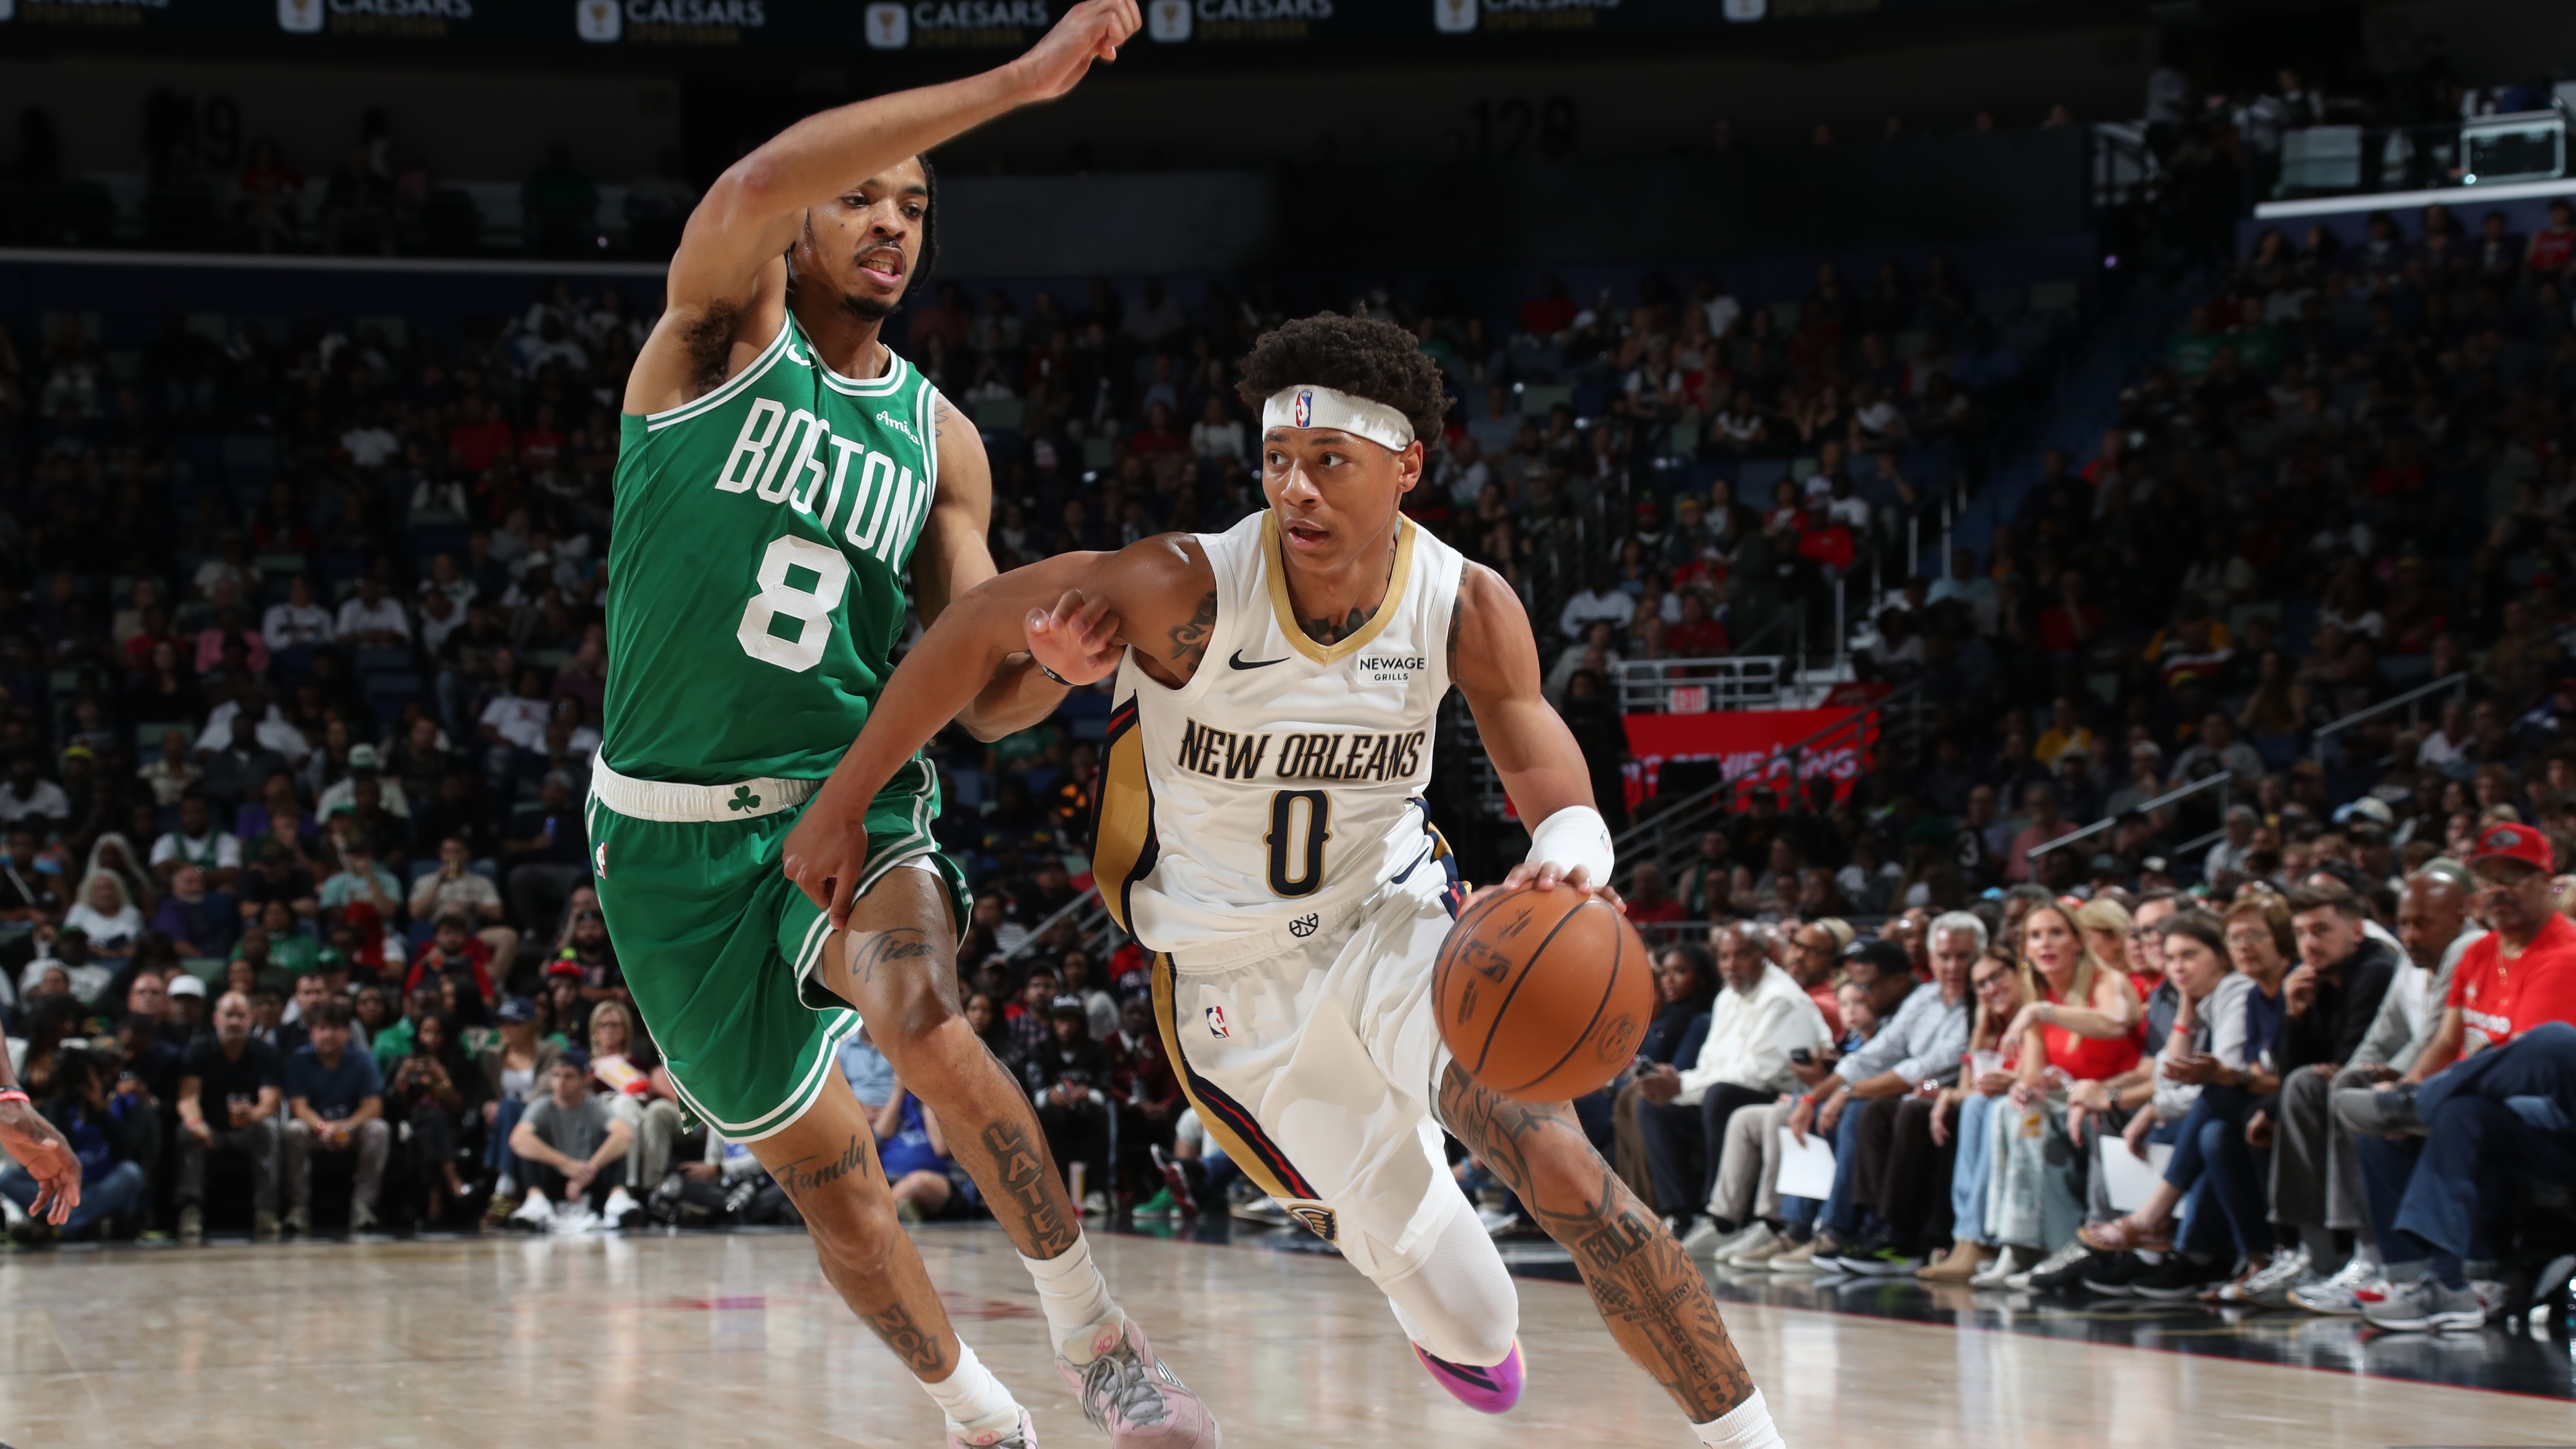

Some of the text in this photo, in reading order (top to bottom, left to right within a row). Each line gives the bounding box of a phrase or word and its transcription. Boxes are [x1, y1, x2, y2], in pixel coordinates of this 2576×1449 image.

[625, 0, 765, 27] CAESARS
[913, 1, 1049, 28] CAESARS
[714, 396, 926, 576] BOSTON
[736, 534, 851, 673] 8
[1360, 657, 1425, 670] NEWAGE
[1178, 717, 1426, 783] NEW ORLEANS
[1263, 790, 1333, 899] 0
[773, 1134, 868, 1198] Family
[988, 1127, 1073, 1259] LATER
